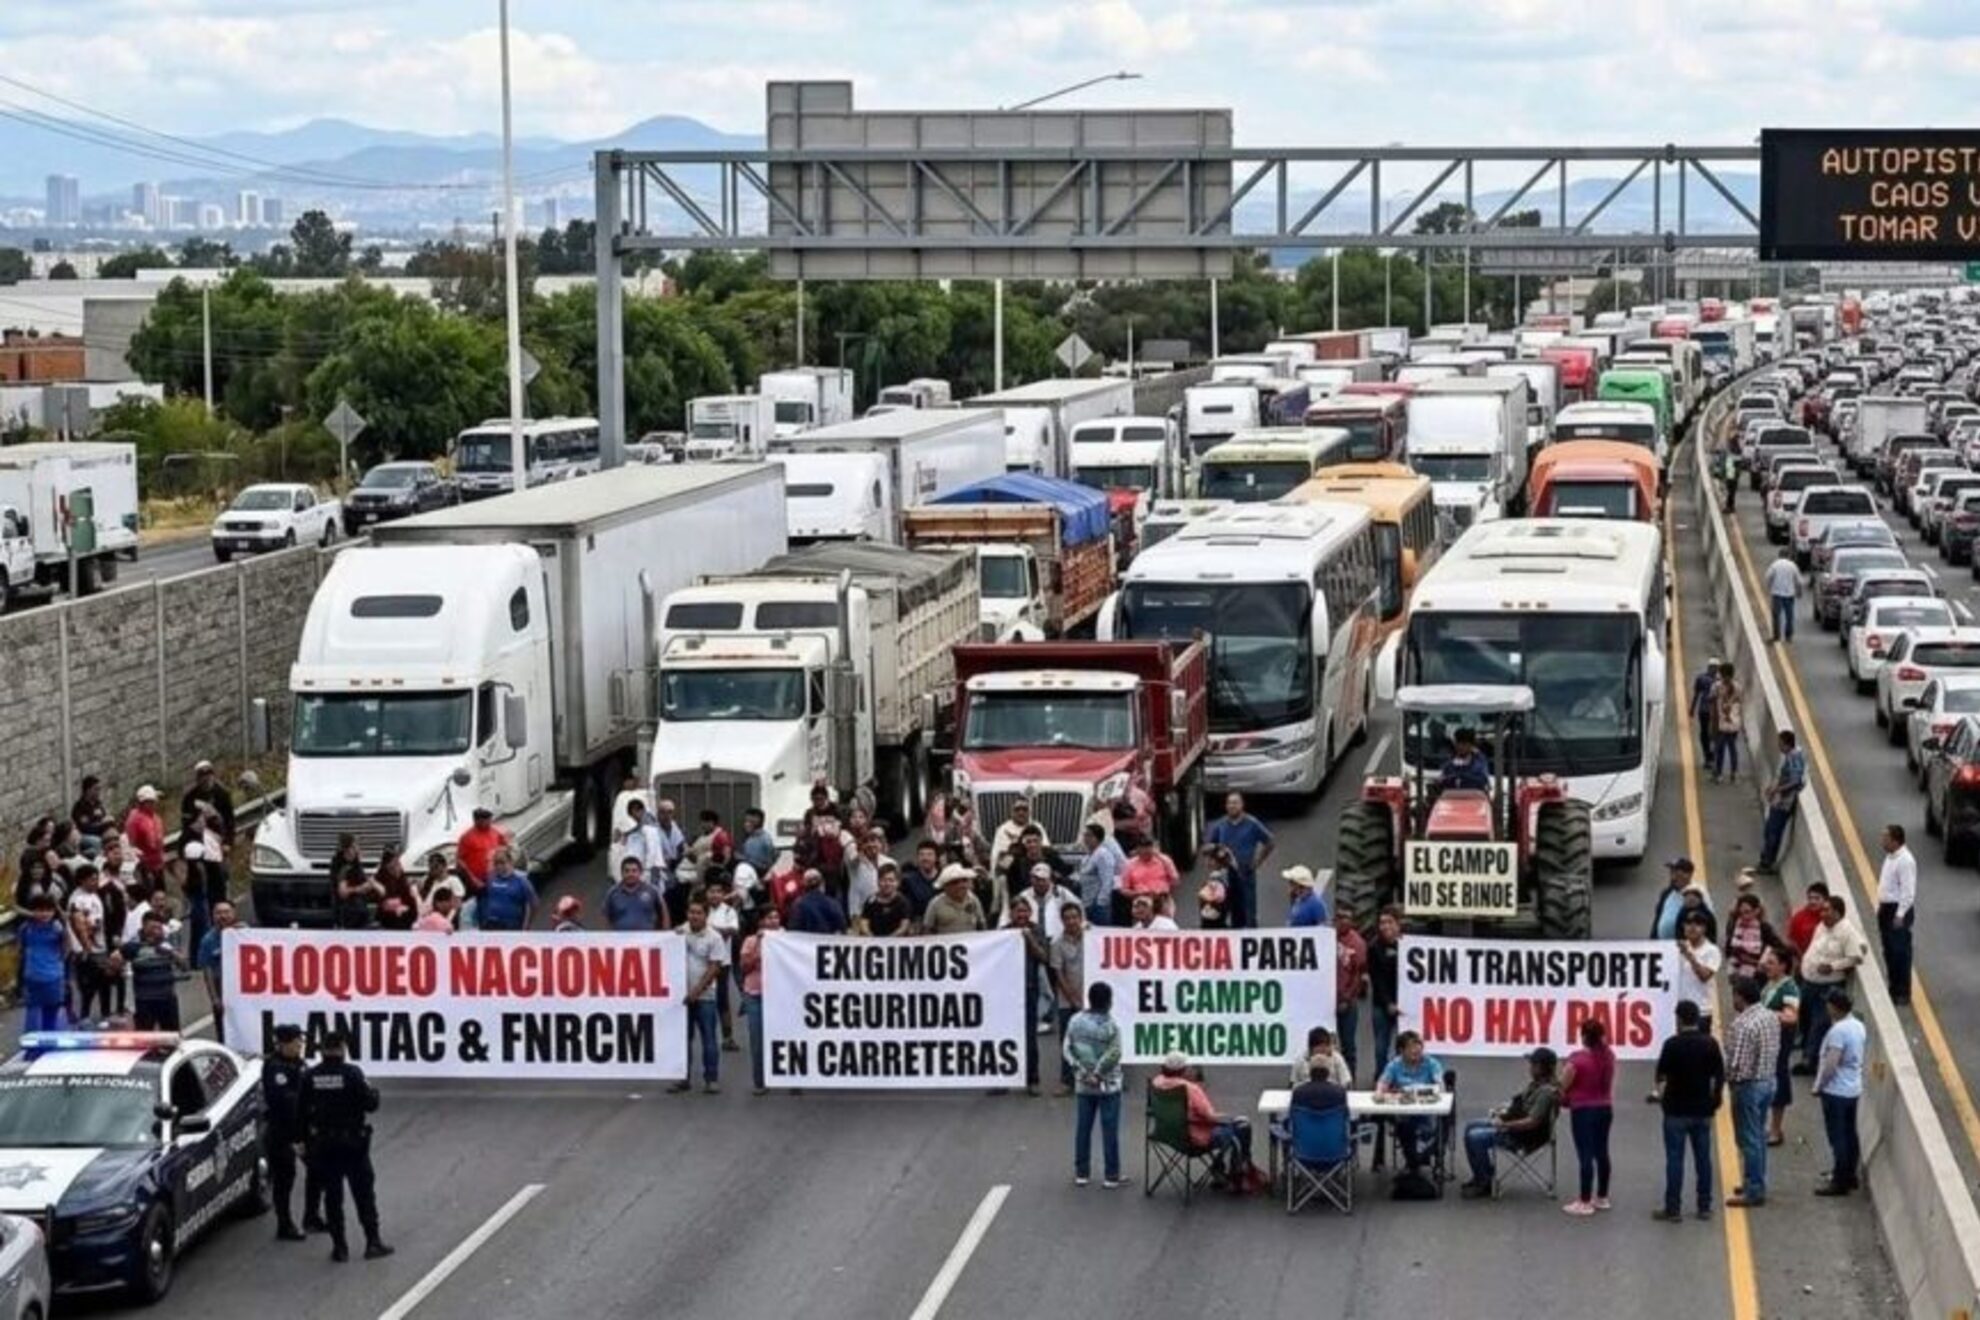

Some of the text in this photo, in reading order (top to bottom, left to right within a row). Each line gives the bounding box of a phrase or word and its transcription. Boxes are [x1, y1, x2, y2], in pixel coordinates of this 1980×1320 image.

[1822, 148, 1980, 174] AUTOPIST
[1871, 181, 1949, 207] CAOS
[1840, 215, 1980, 240] TOMAR V
[1413, 847, 1509, 875] EL CAMPO
[1408, 881, 1432, 906] NO
[1436, 881, 1458, 907] SE
[239, 944, 670, 1000] BLOQUEO NACIONAL
[816, 944, 969, 981] EXIGIMOS
[1101, 937, 1319, 971] JUSTICIA PARA
[1406, 946, 1670, 992] SIN TRANSPORTE,
[804, 992, 983, 1030] SEGURIDAD
[1138, 979, 1283, 1014] EL CAMPO
[1423, 991, 1653, 1048] NO HAY PAÍS
[458, 1019, 490, 1063] &
[501, 1012, 655, 1064] FNRCM
[1134, 1022, 1287, 1058] MEXICANO
[771, 1039, 1018, 1077] EN CARRETERAS
